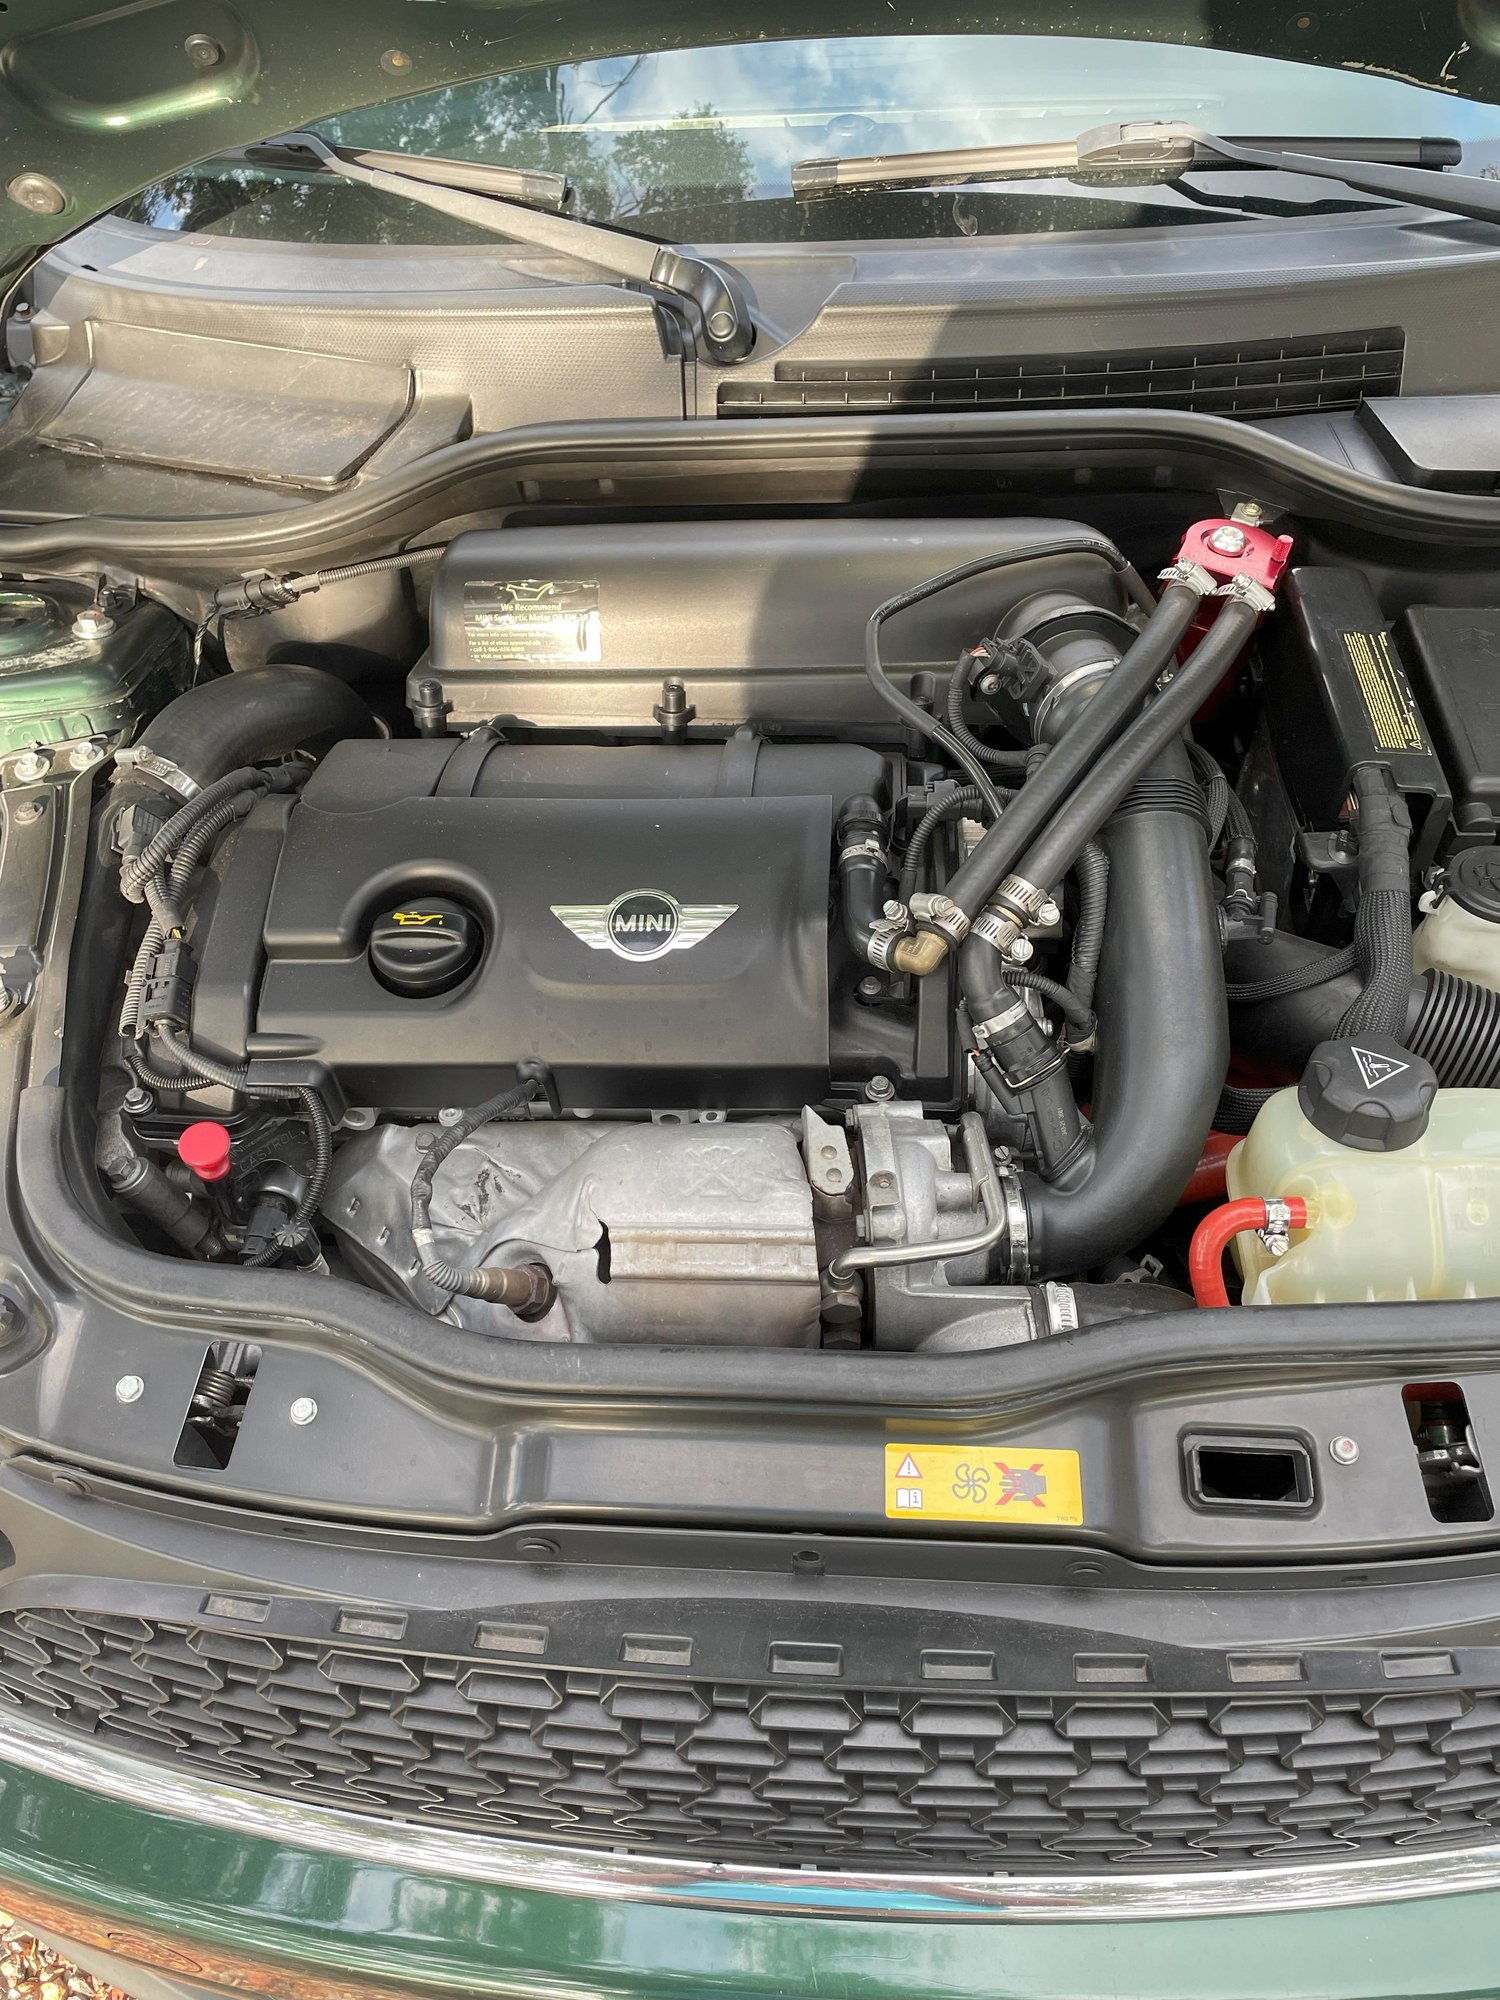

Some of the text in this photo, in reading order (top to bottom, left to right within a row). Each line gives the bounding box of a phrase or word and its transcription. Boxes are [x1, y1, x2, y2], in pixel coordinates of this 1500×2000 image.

[501, 602, 561, 611] We Recommend
[615, 914, 673, 933] MINI
[239, 1130, 298, 1172] CASTROL
